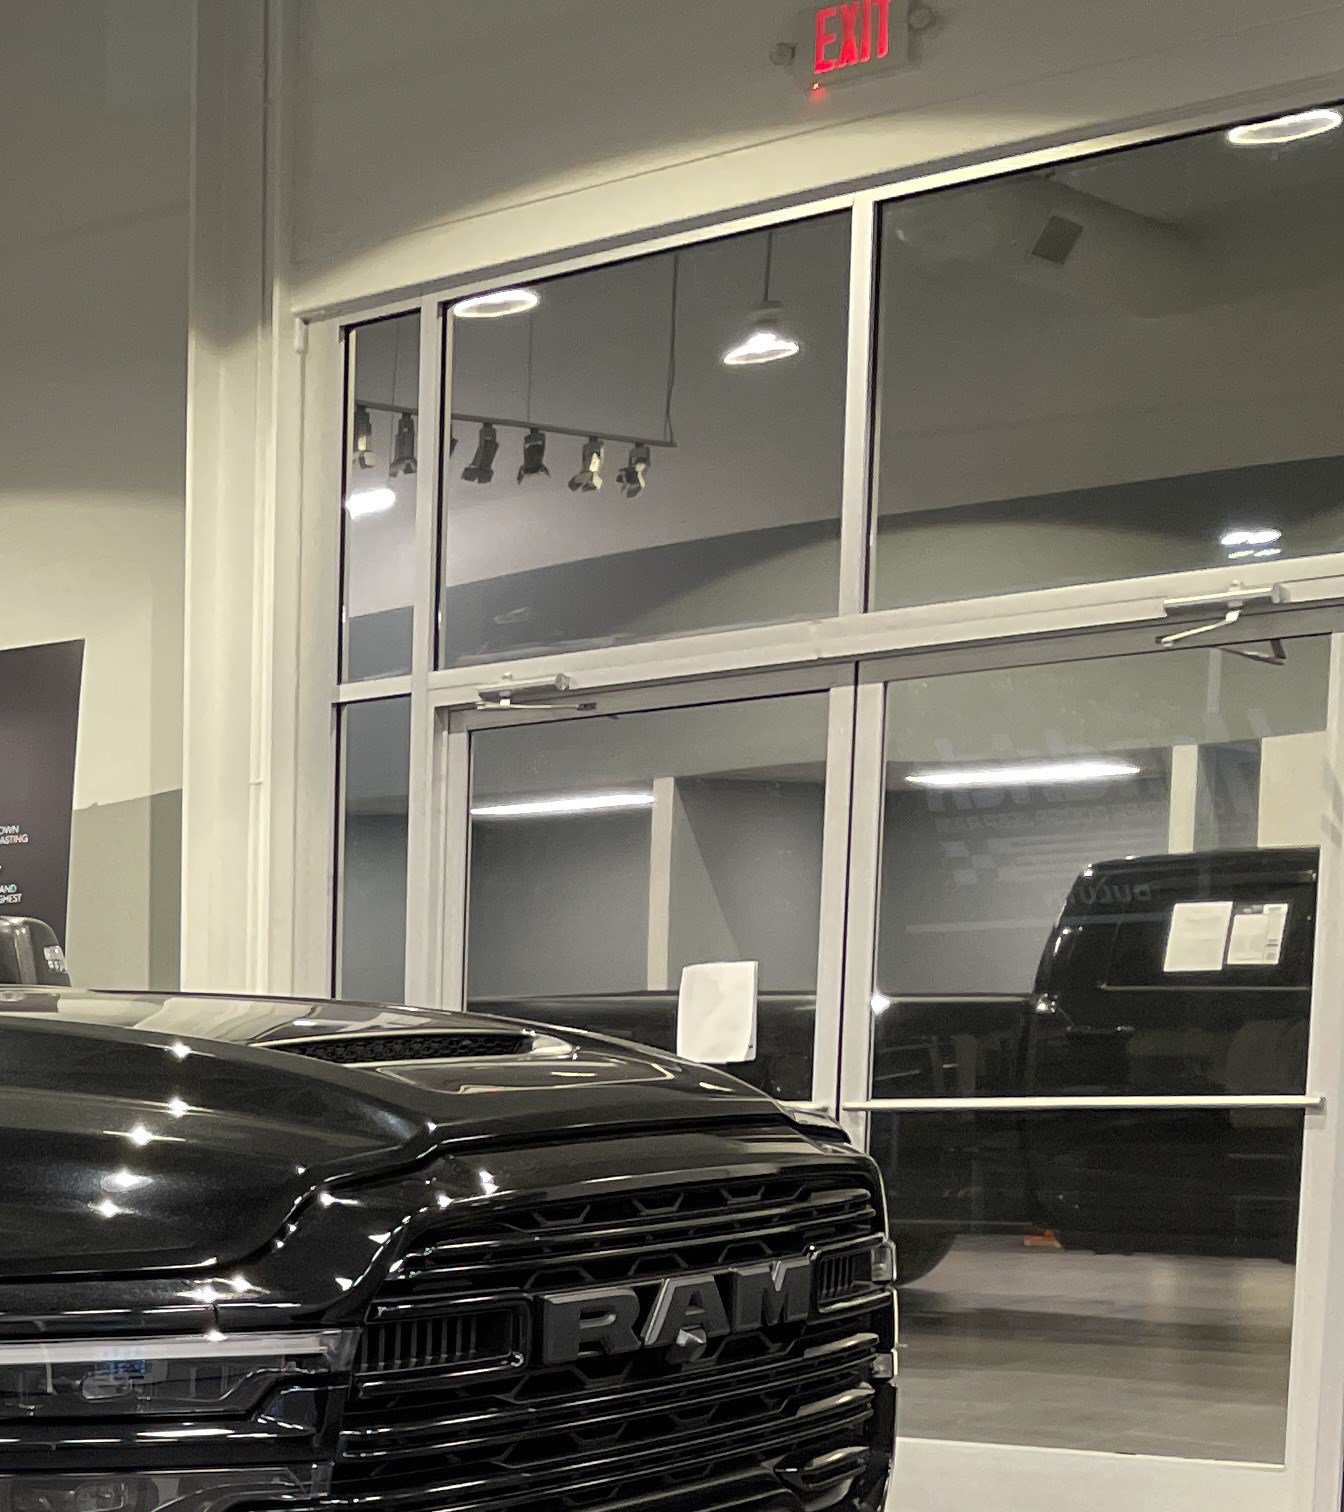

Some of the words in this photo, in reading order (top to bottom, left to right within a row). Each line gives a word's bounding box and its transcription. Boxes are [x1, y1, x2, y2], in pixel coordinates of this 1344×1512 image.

[813, 0, 890, 75] EXIT
[0, 883, 17, 893] AND
[543, 1256, 811, 1364] RAM
